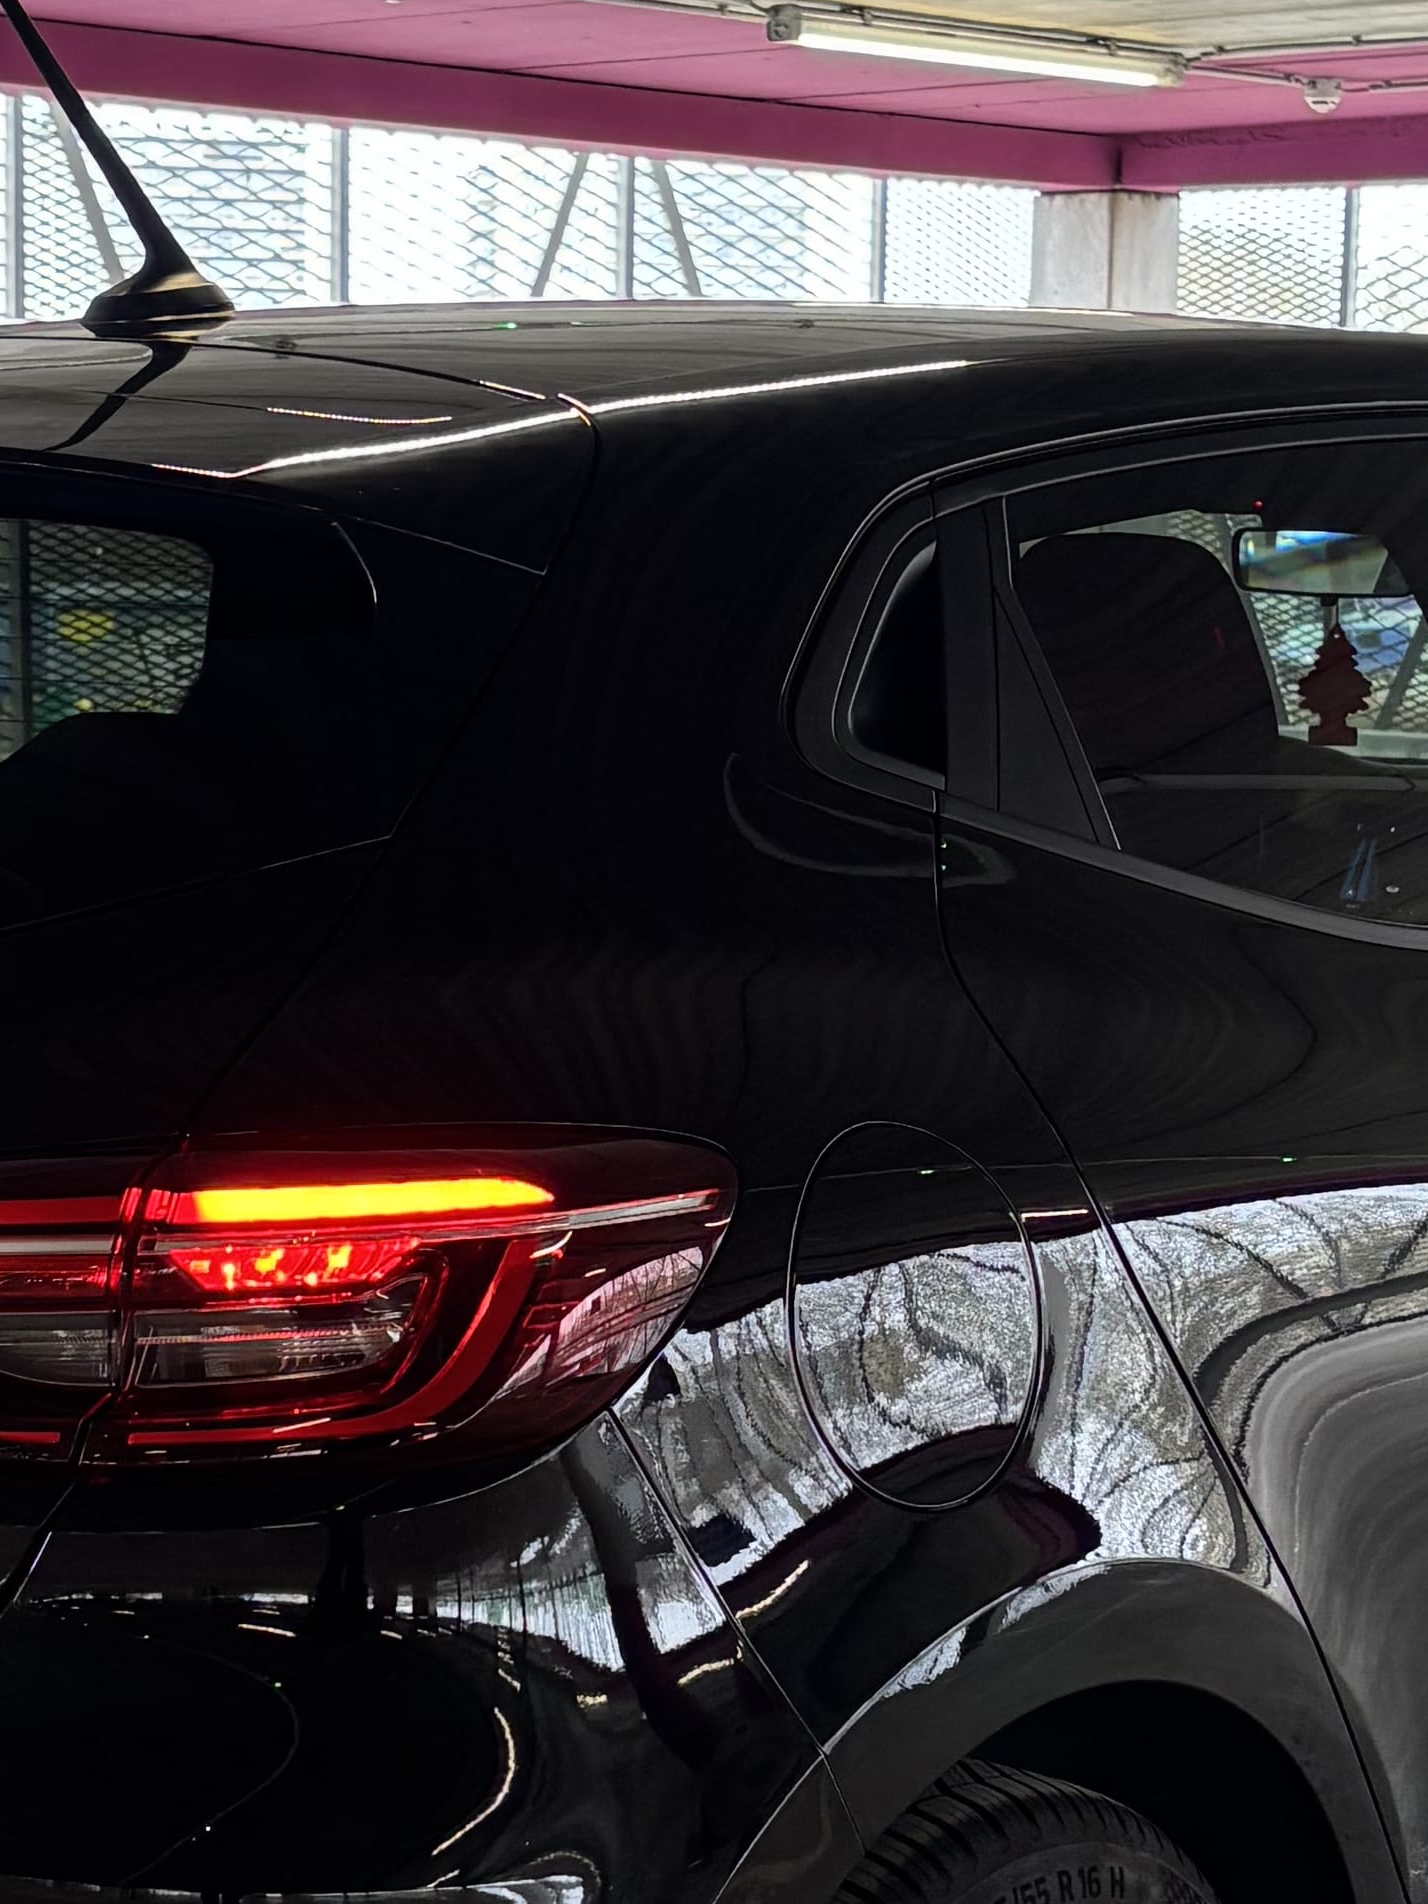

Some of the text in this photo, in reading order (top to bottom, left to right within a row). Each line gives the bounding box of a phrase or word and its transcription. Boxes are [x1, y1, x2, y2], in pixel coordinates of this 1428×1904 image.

[1057, 1870, 1075, 1903] R
[1078, 1865, 1102, 1899] 16
[1109, 1866, 1125, 1899] H
